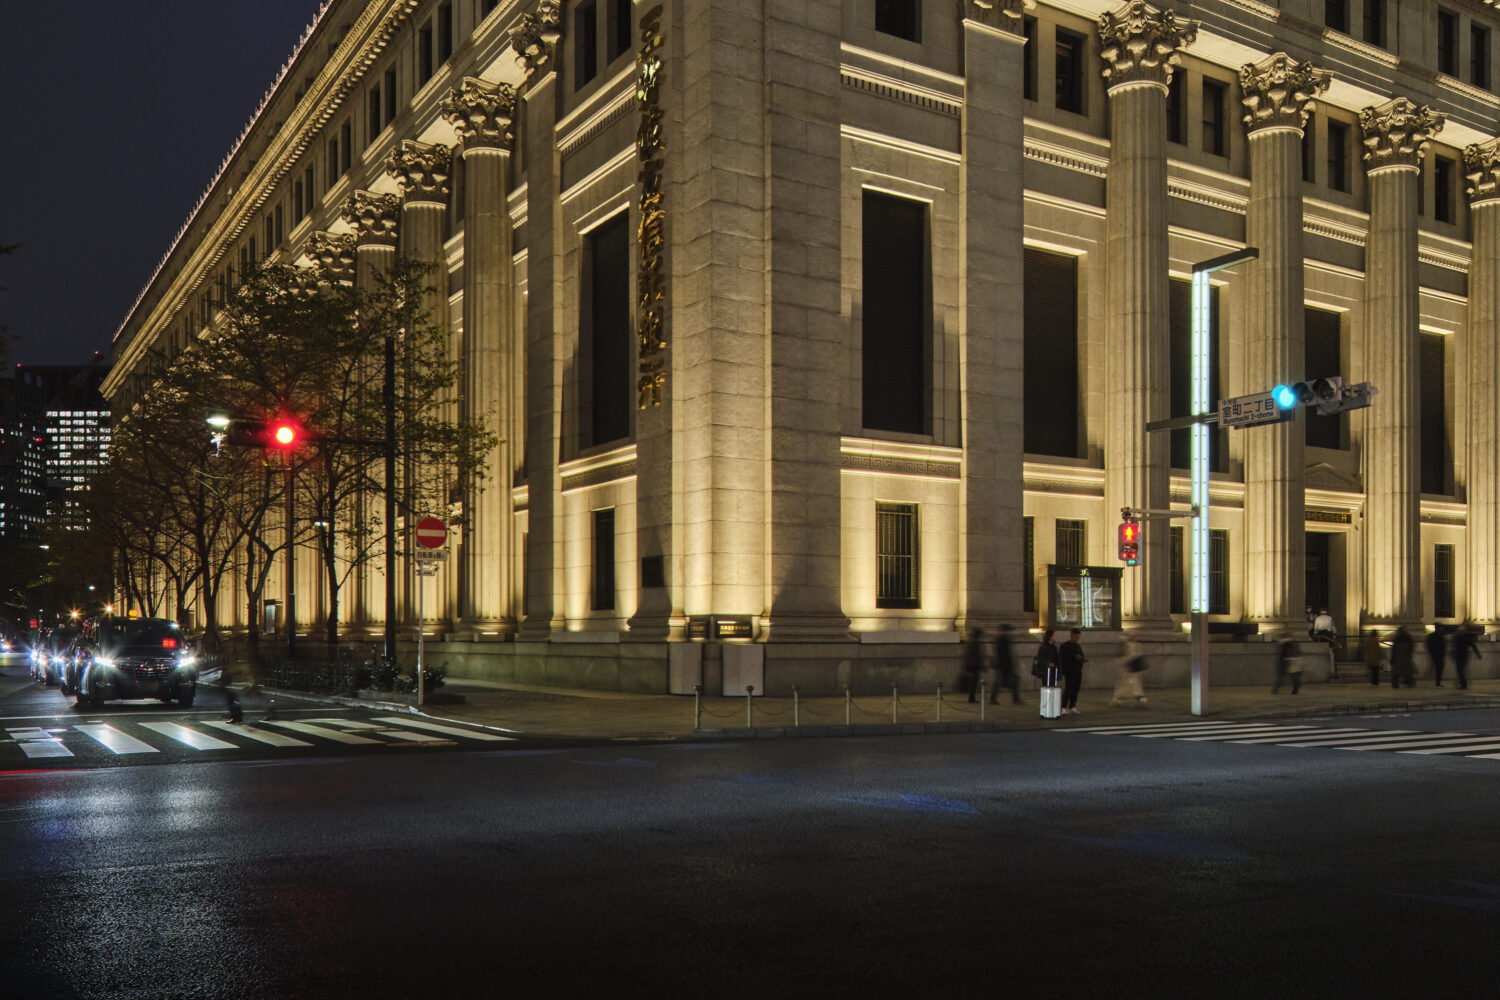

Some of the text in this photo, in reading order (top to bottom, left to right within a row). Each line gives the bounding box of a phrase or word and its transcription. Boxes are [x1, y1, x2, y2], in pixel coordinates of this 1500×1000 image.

[1222, 398, 1274, 418] 室町二丁目
